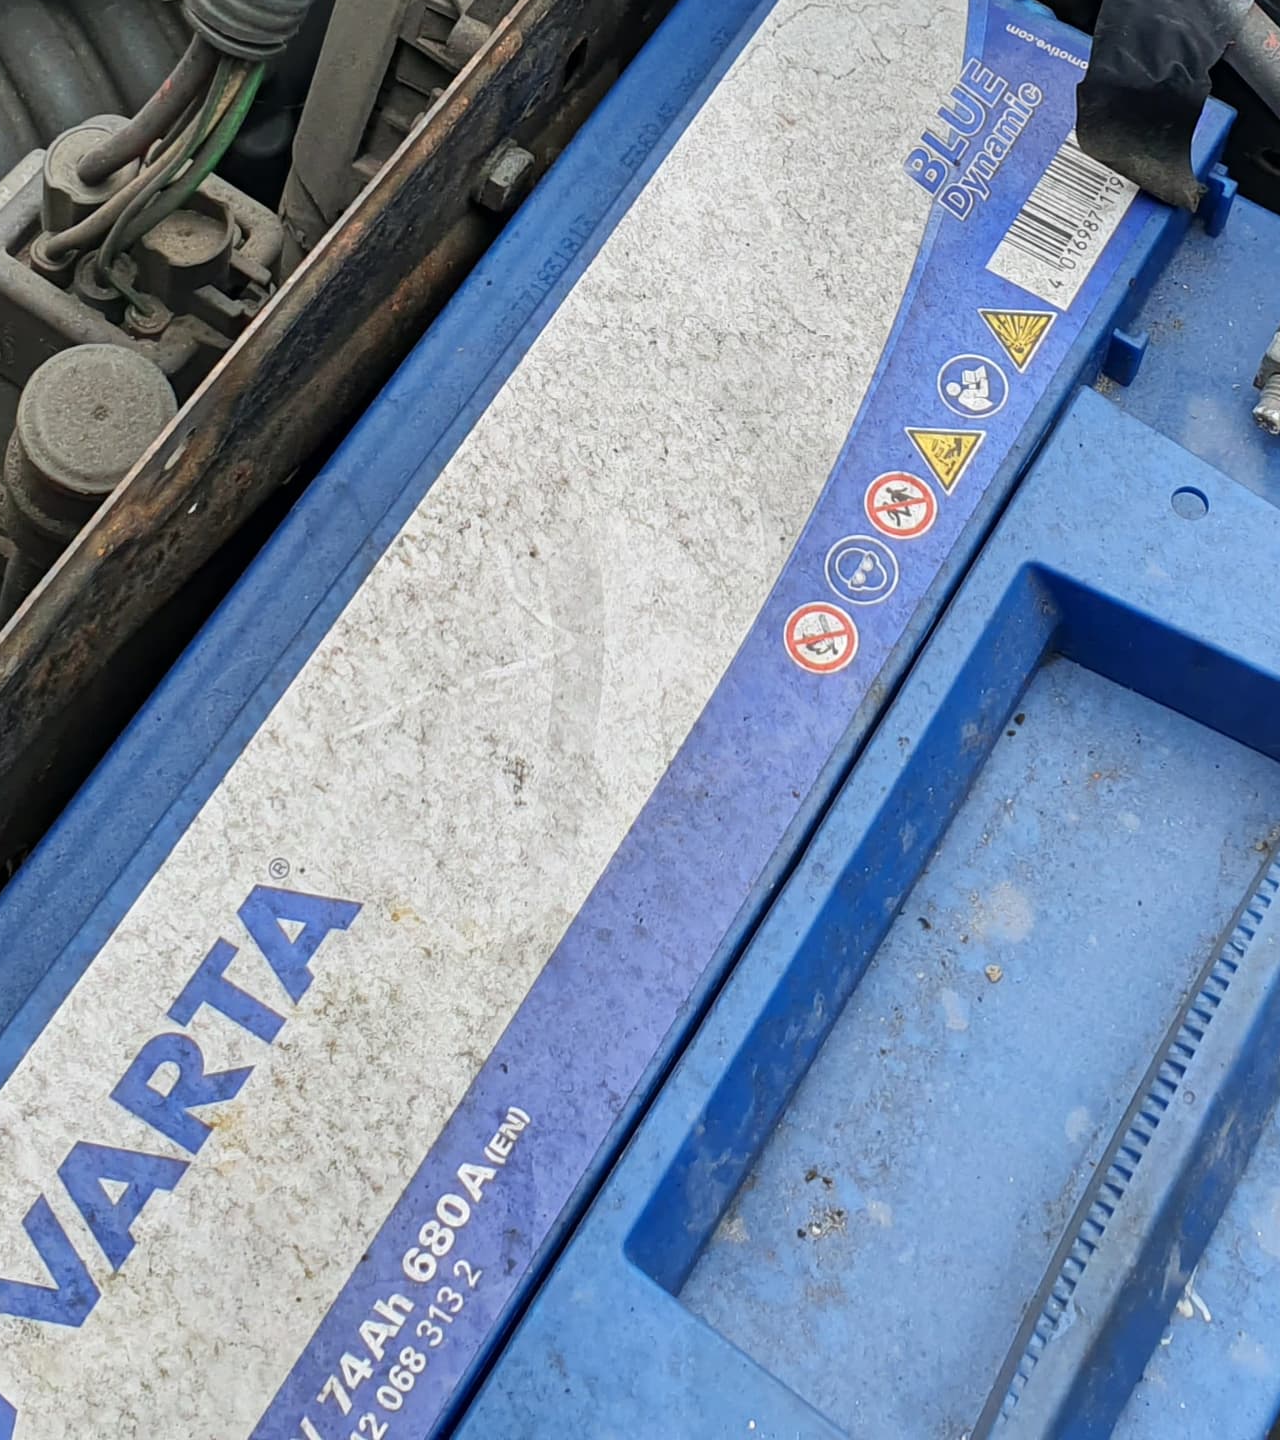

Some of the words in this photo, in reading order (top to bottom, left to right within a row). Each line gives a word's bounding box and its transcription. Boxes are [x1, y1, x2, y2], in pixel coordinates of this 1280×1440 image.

[903, 58, 1008, 197] BLUE
[937, 82, 1043, 222] Dynamic
[1059, 209, 1104, 271] 016987
[316, 1293, 416, 1416] 74Ah
[376, 1346, 427, 1412] 068
[416, 1286, 464, 1347] 313
[453, 1259, 483, 1288] 2
